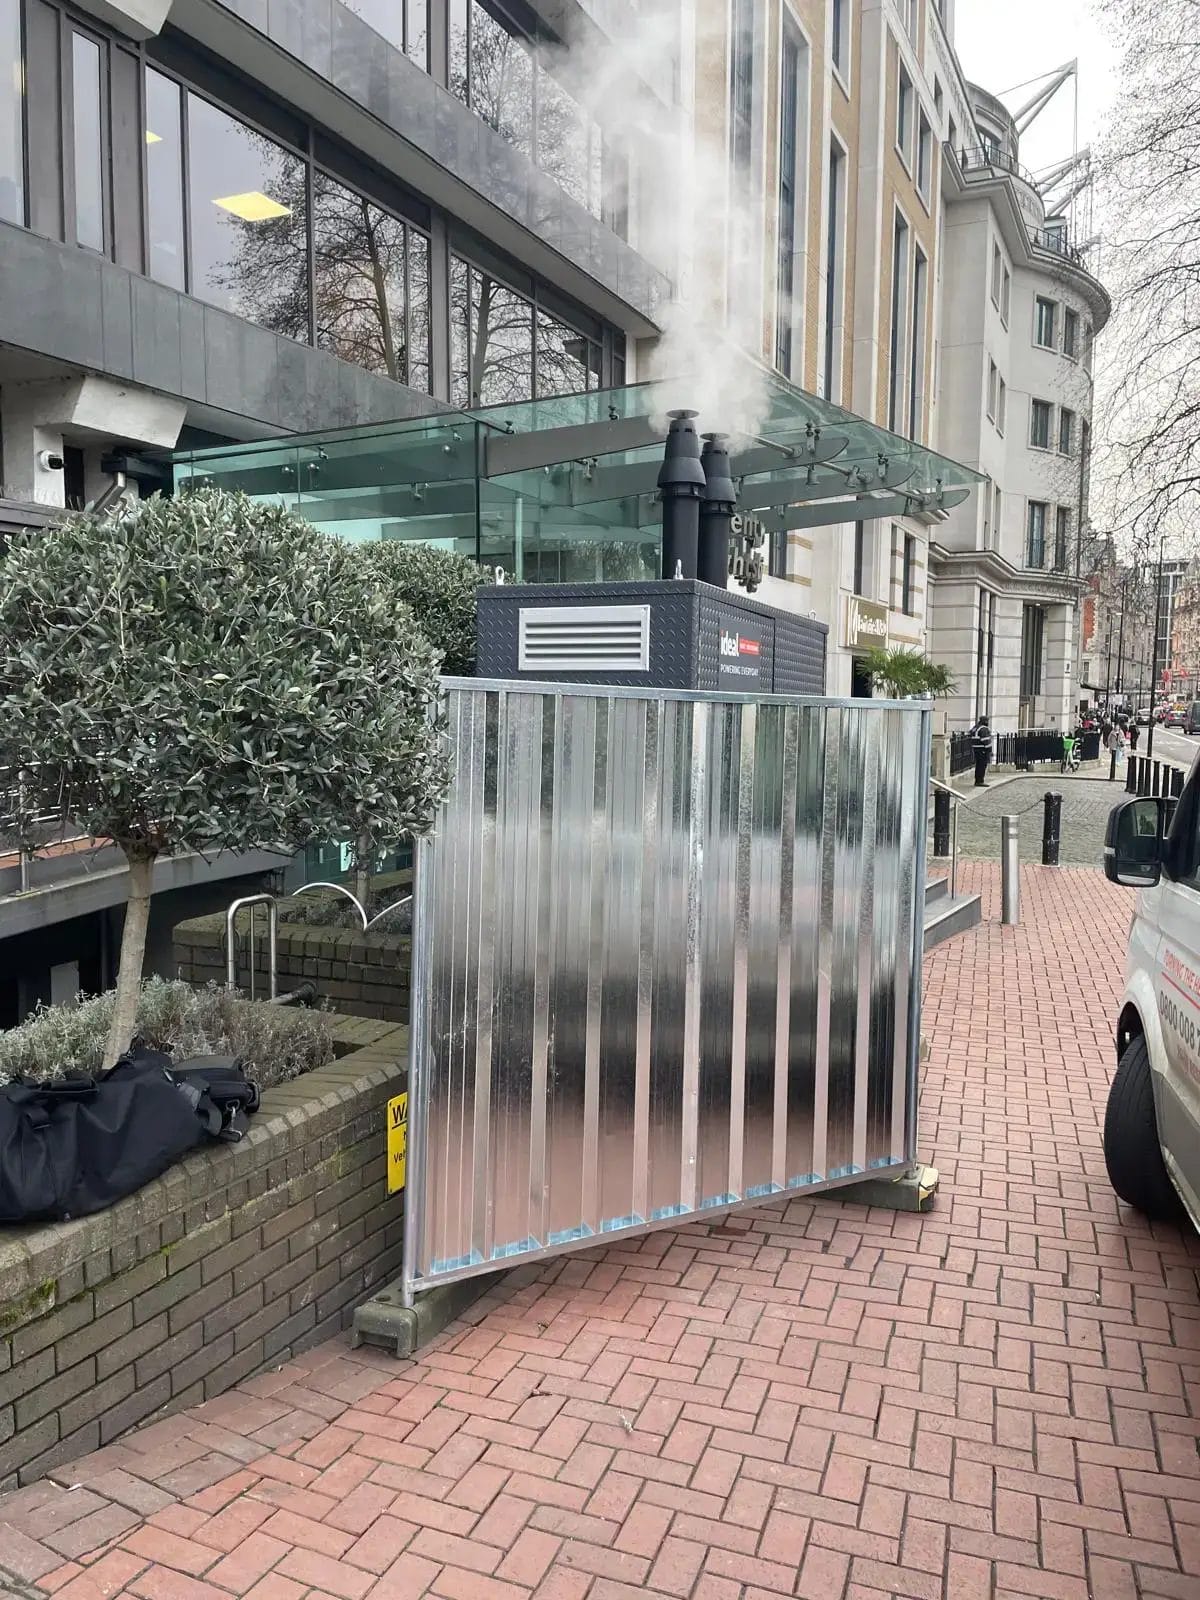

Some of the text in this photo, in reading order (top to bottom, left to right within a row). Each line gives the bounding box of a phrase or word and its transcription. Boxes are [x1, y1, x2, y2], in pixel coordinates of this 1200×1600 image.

[720, 629, 740, 657] ideal
[1160, 990, 1178, 1031] 0800
[1179, 1011, 1195, 1050] 008
